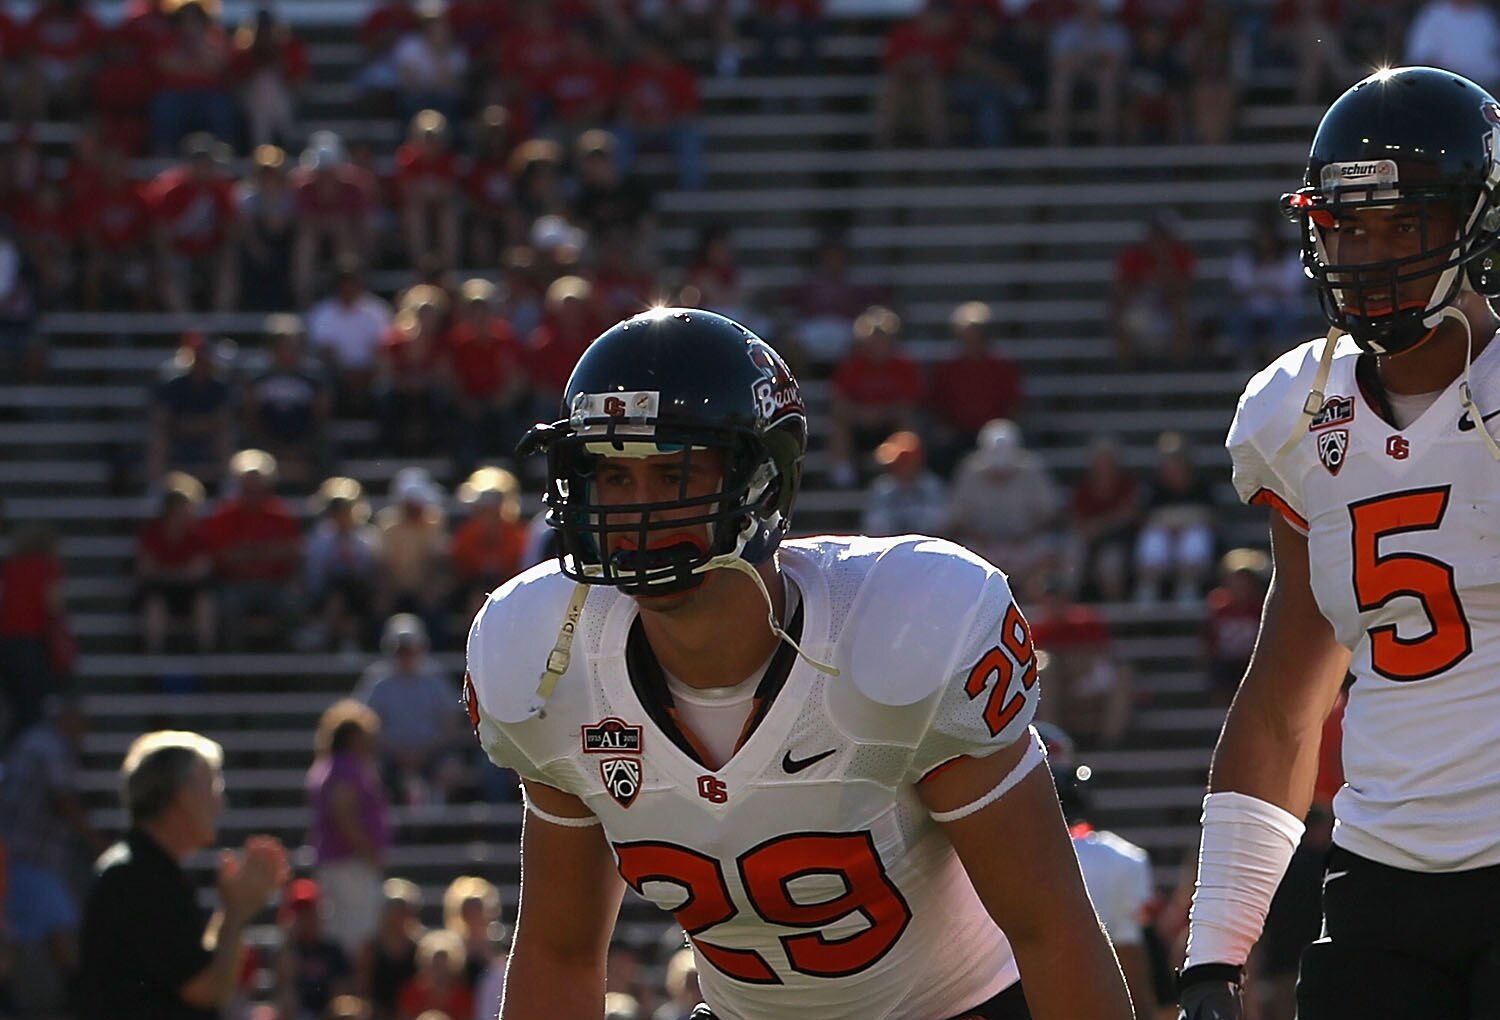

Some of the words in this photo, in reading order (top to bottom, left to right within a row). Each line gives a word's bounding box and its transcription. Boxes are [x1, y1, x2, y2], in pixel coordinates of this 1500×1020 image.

[1347, 484, 1473, 682] 5
[964, 600, 1038, 739] 29
[600, 731, 628, 748] AL
[602, 759, 639, 788] PAC
[613, 779, 635, 798] 10
[611, 830, 912, 985] 29
